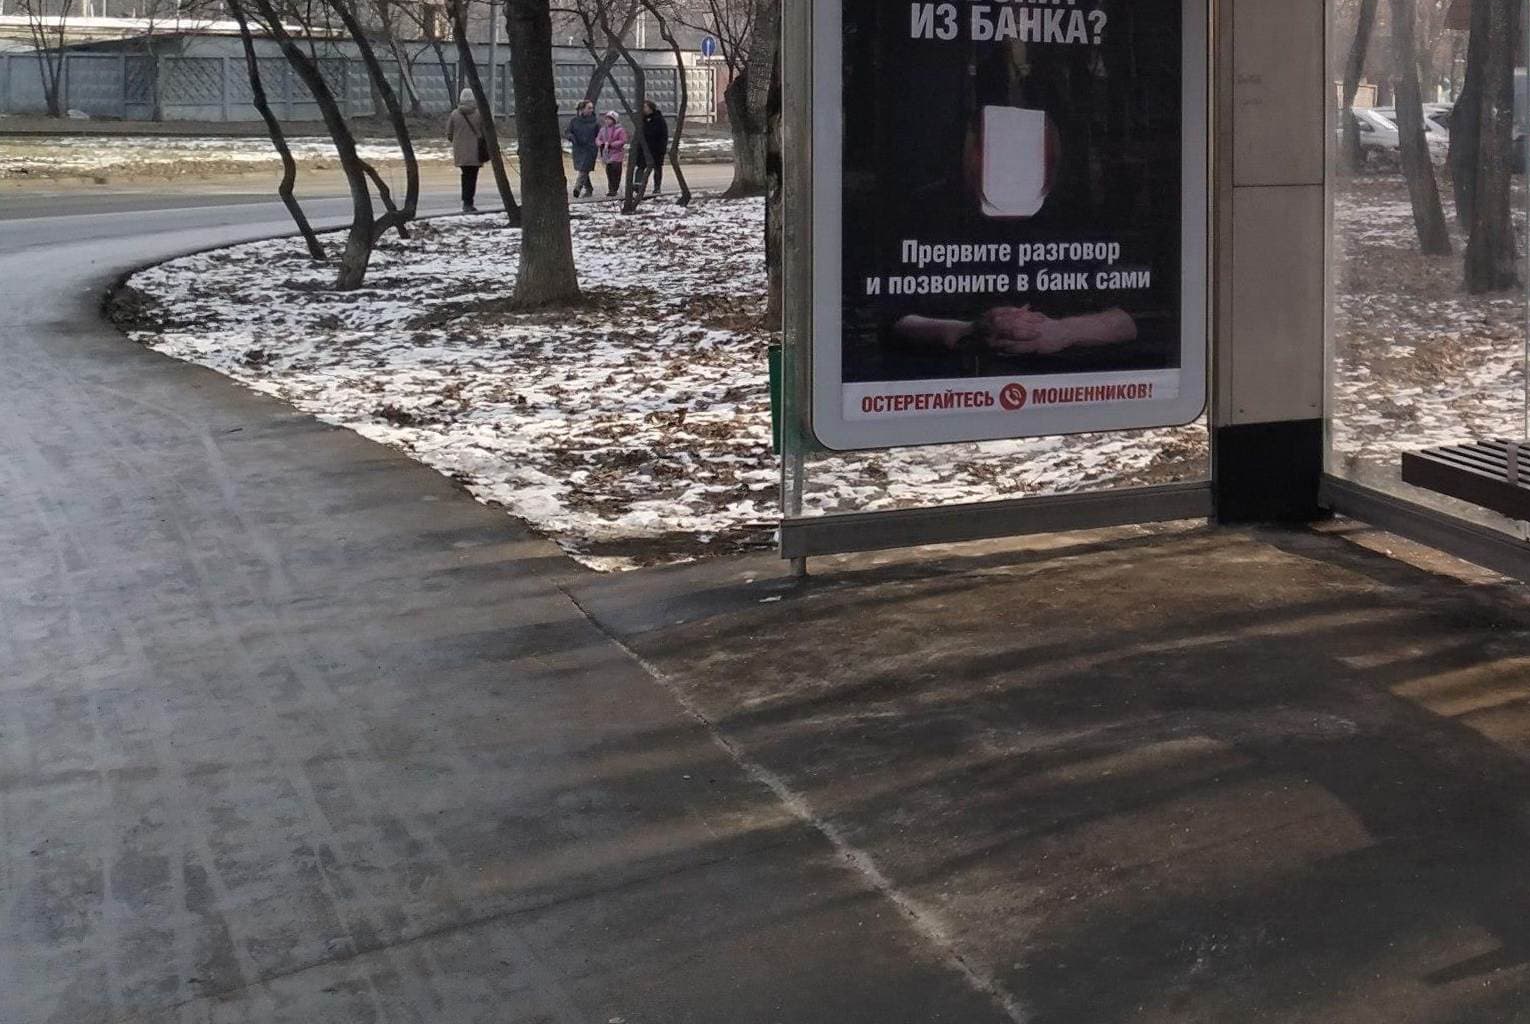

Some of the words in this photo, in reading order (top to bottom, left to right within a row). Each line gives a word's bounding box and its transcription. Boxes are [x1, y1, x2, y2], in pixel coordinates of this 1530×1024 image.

[910, 2, 958, 41] ИЗ
[971, 5, 1108, 45] БАНКА?
[901, 239, 1011, 268] Прервите
[1018, 241, 1121, 267] разговор
[866, 276, 881, 295] и
[888, 273, 1010, 294] позвоните
[1016, 274, 1030, 292] в
[1036, 268, 1089, 292] банк
[1095, 269, 1151, 290] сами
[861, 388, 995, 413] ОСТЕРЕГАЙТЕСЬ
[1031, 383, 1154, 405] МОШЕННИКОВ!
